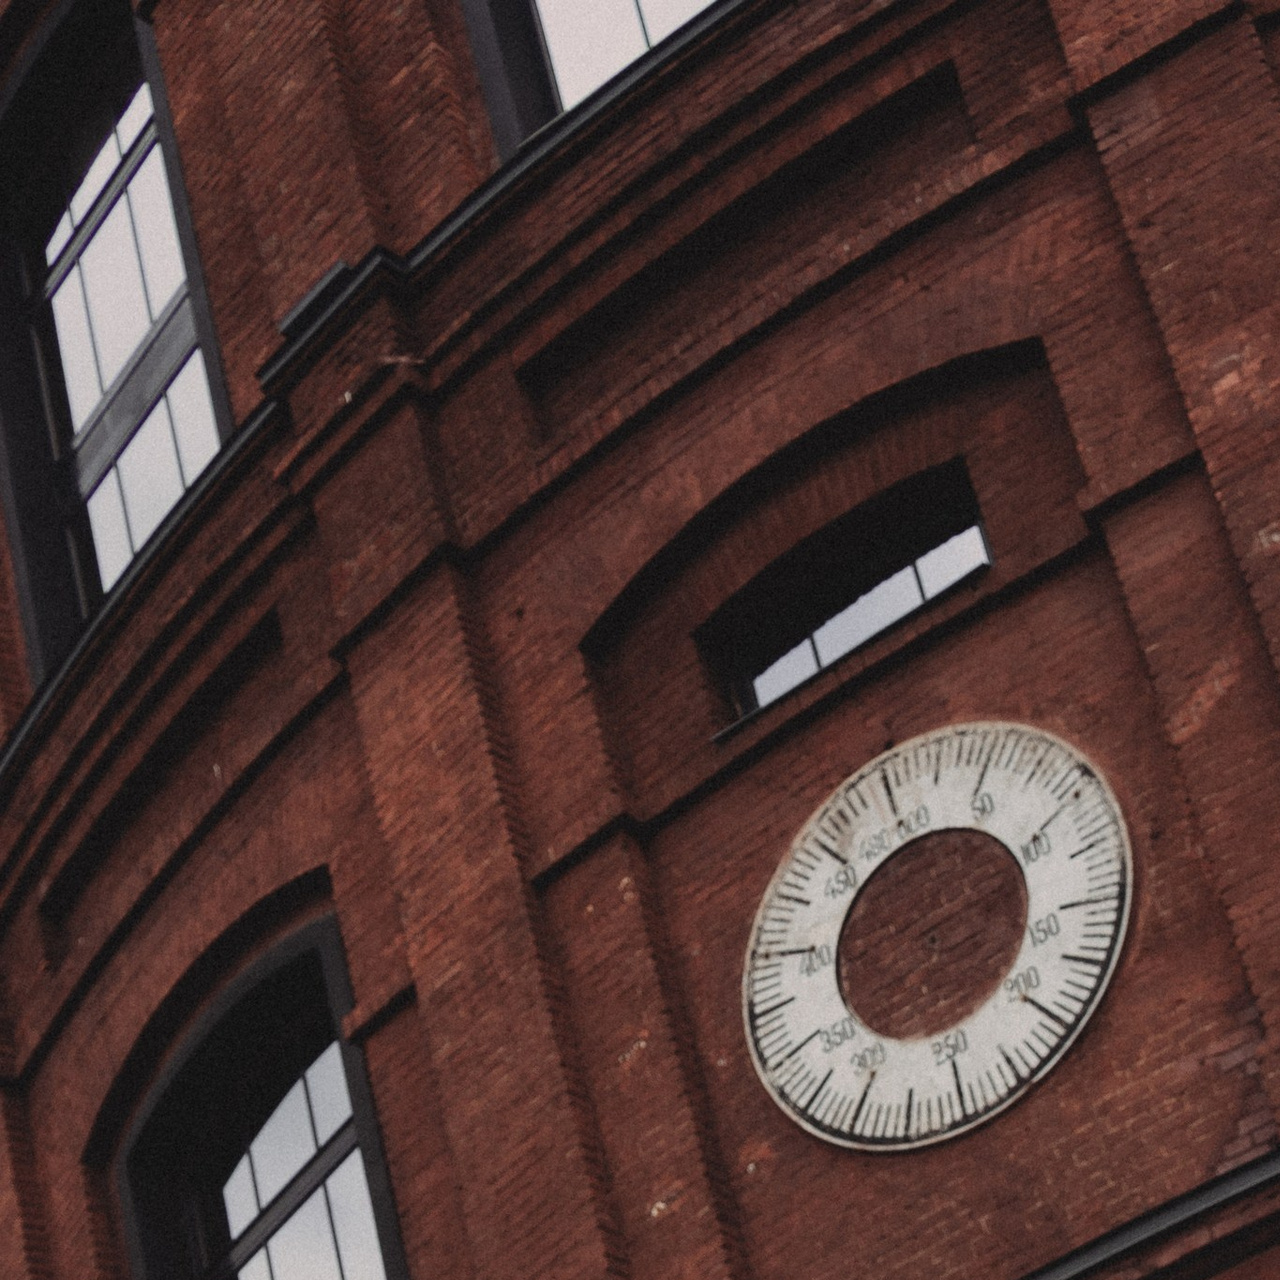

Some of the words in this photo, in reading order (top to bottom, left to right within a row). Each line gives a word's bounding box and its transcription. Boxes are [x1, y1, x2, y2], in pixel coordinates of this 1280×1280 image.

[970, 793, 995, 822] 50
[824, 865, 857, 898] 450
[1028, 913, 1060, 947] 150
[1003, 966, 1040, 1002] 200
[820, 1017, 855, 1053] 350
[931, 1028, 967, 1066] 250
